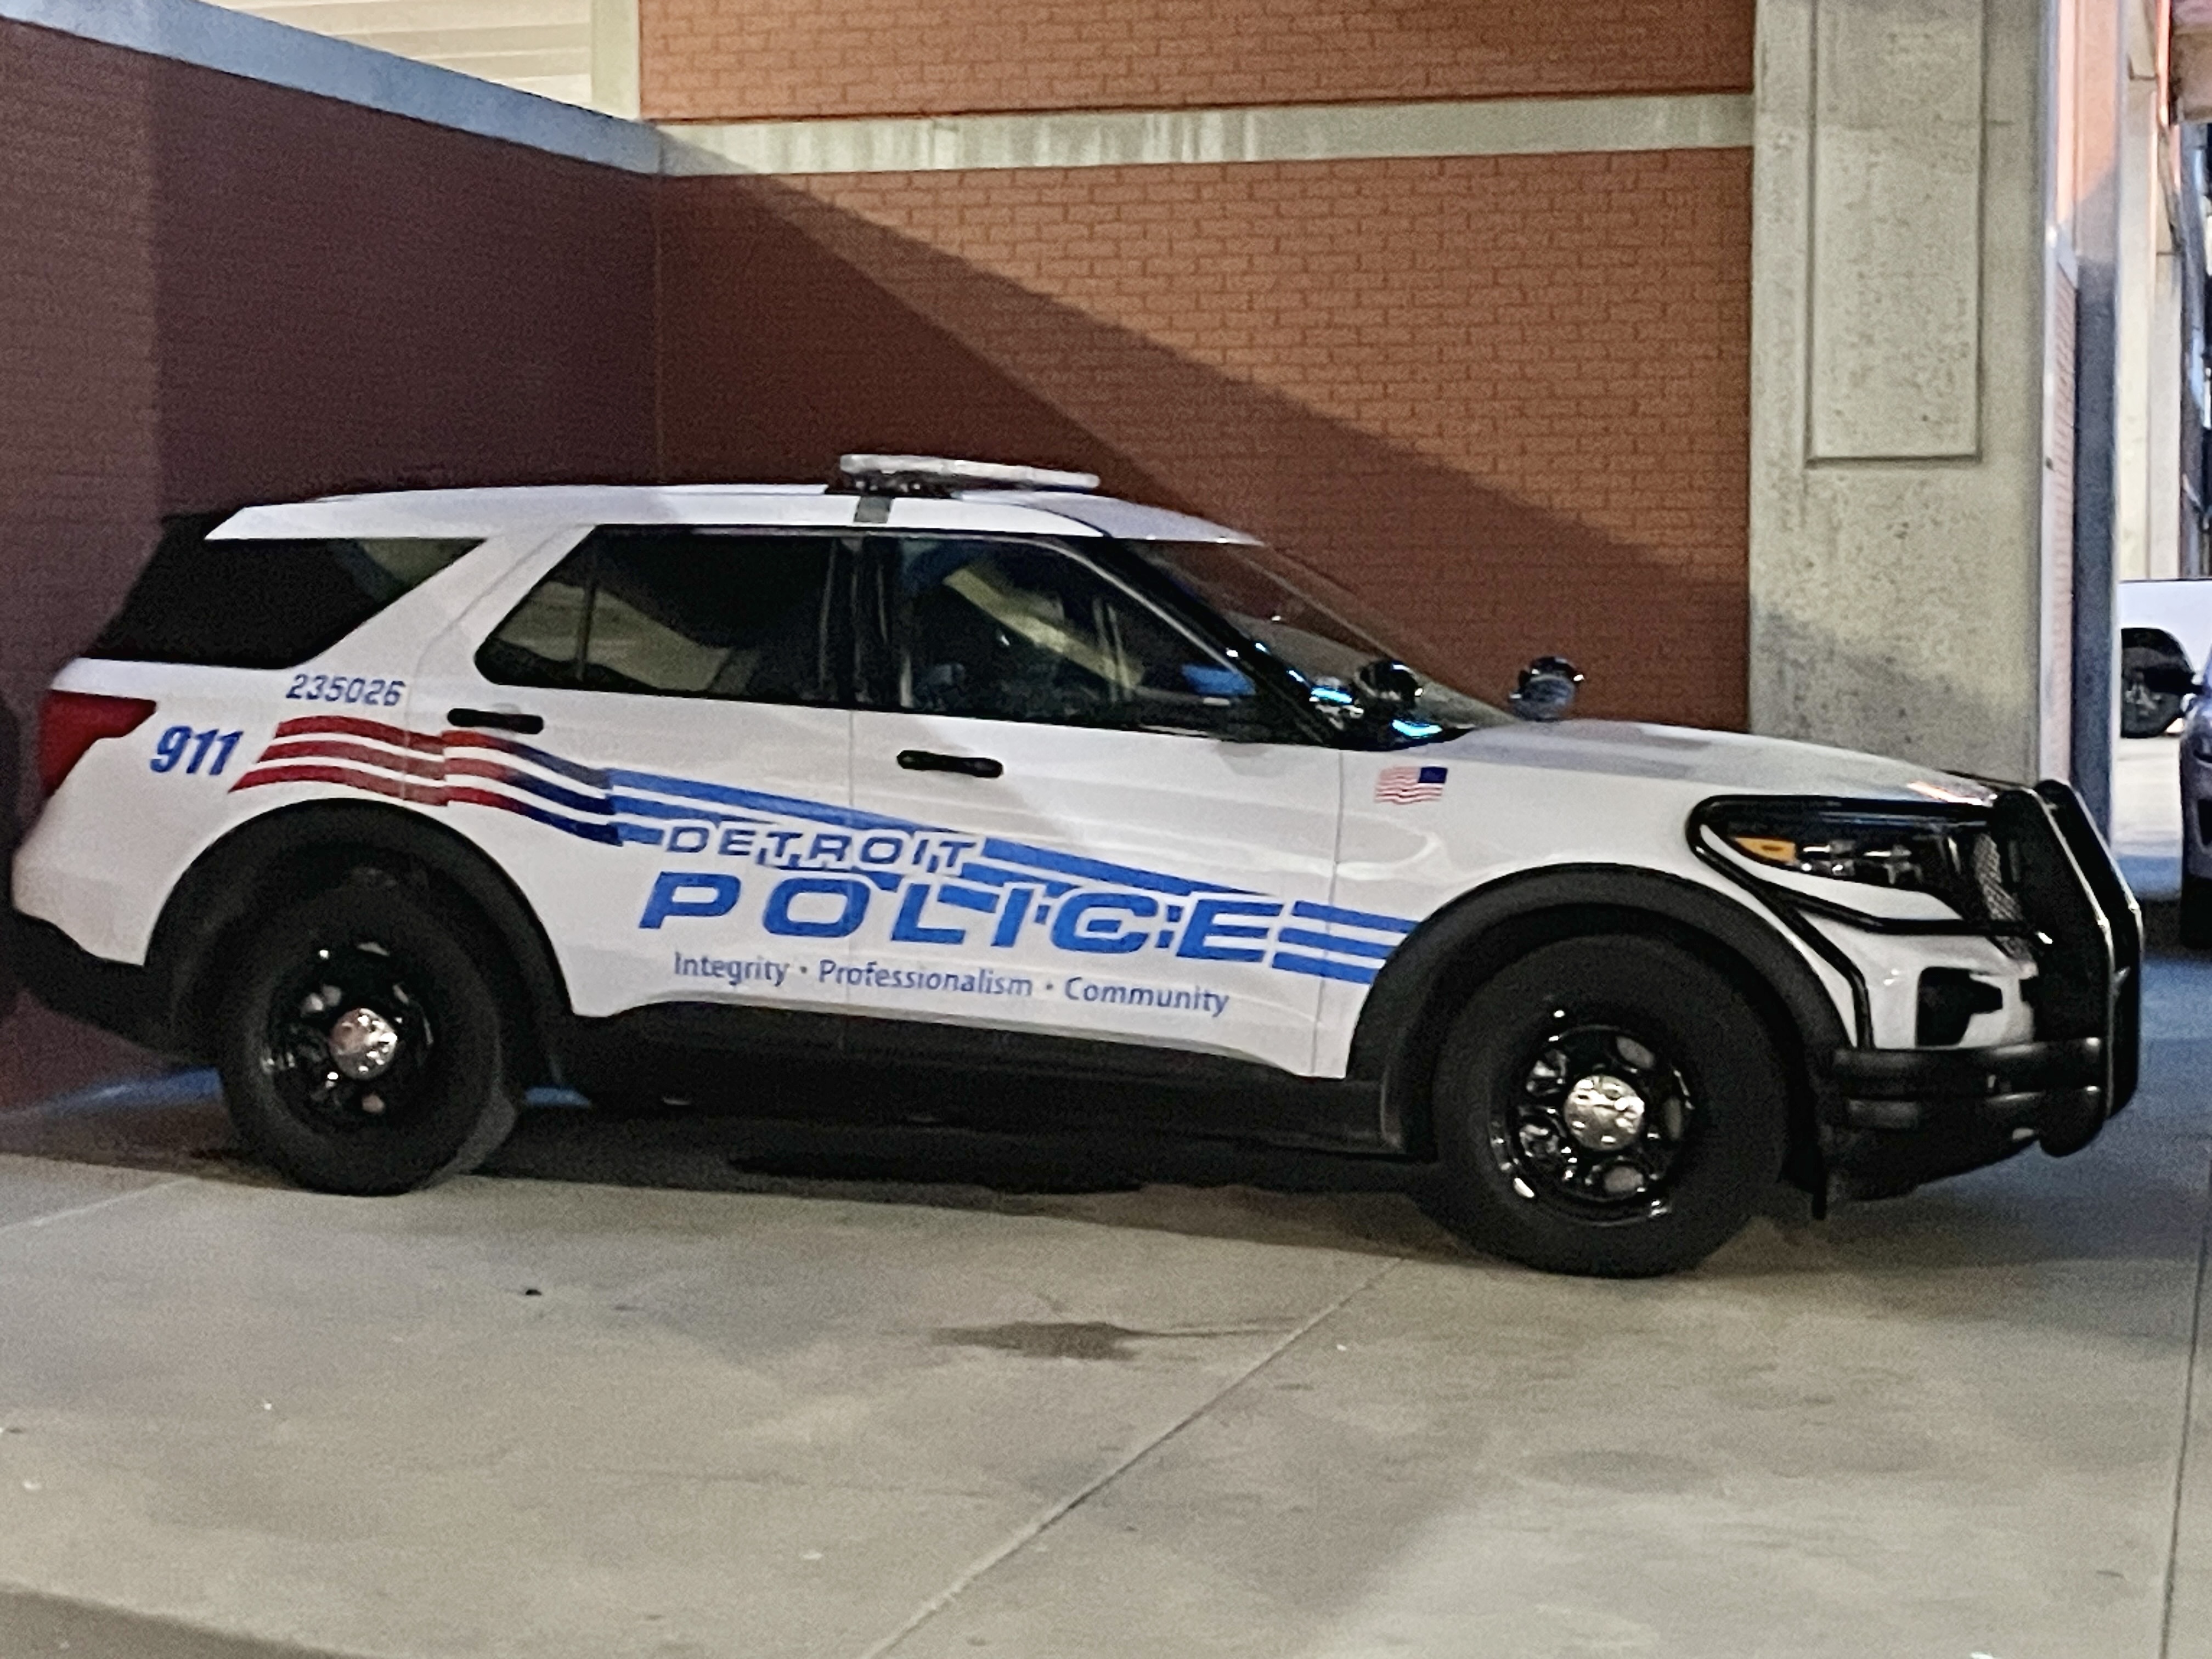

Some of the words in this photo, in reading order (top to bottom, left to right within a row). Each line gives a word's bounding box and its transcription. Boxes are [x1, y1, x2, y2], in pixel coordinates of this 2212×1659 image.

[285, 674, 405, 706] 235026
[150, 725, 244, 775] 911
[665, 826, 978, 868] DETROIT
[639, 871, 1284, 963] POLICE
[674, 952, 789, 987] Integrity
[818, 959, 1033, 996] Professionalism
[1065, 976, 1229, 1017] Community
